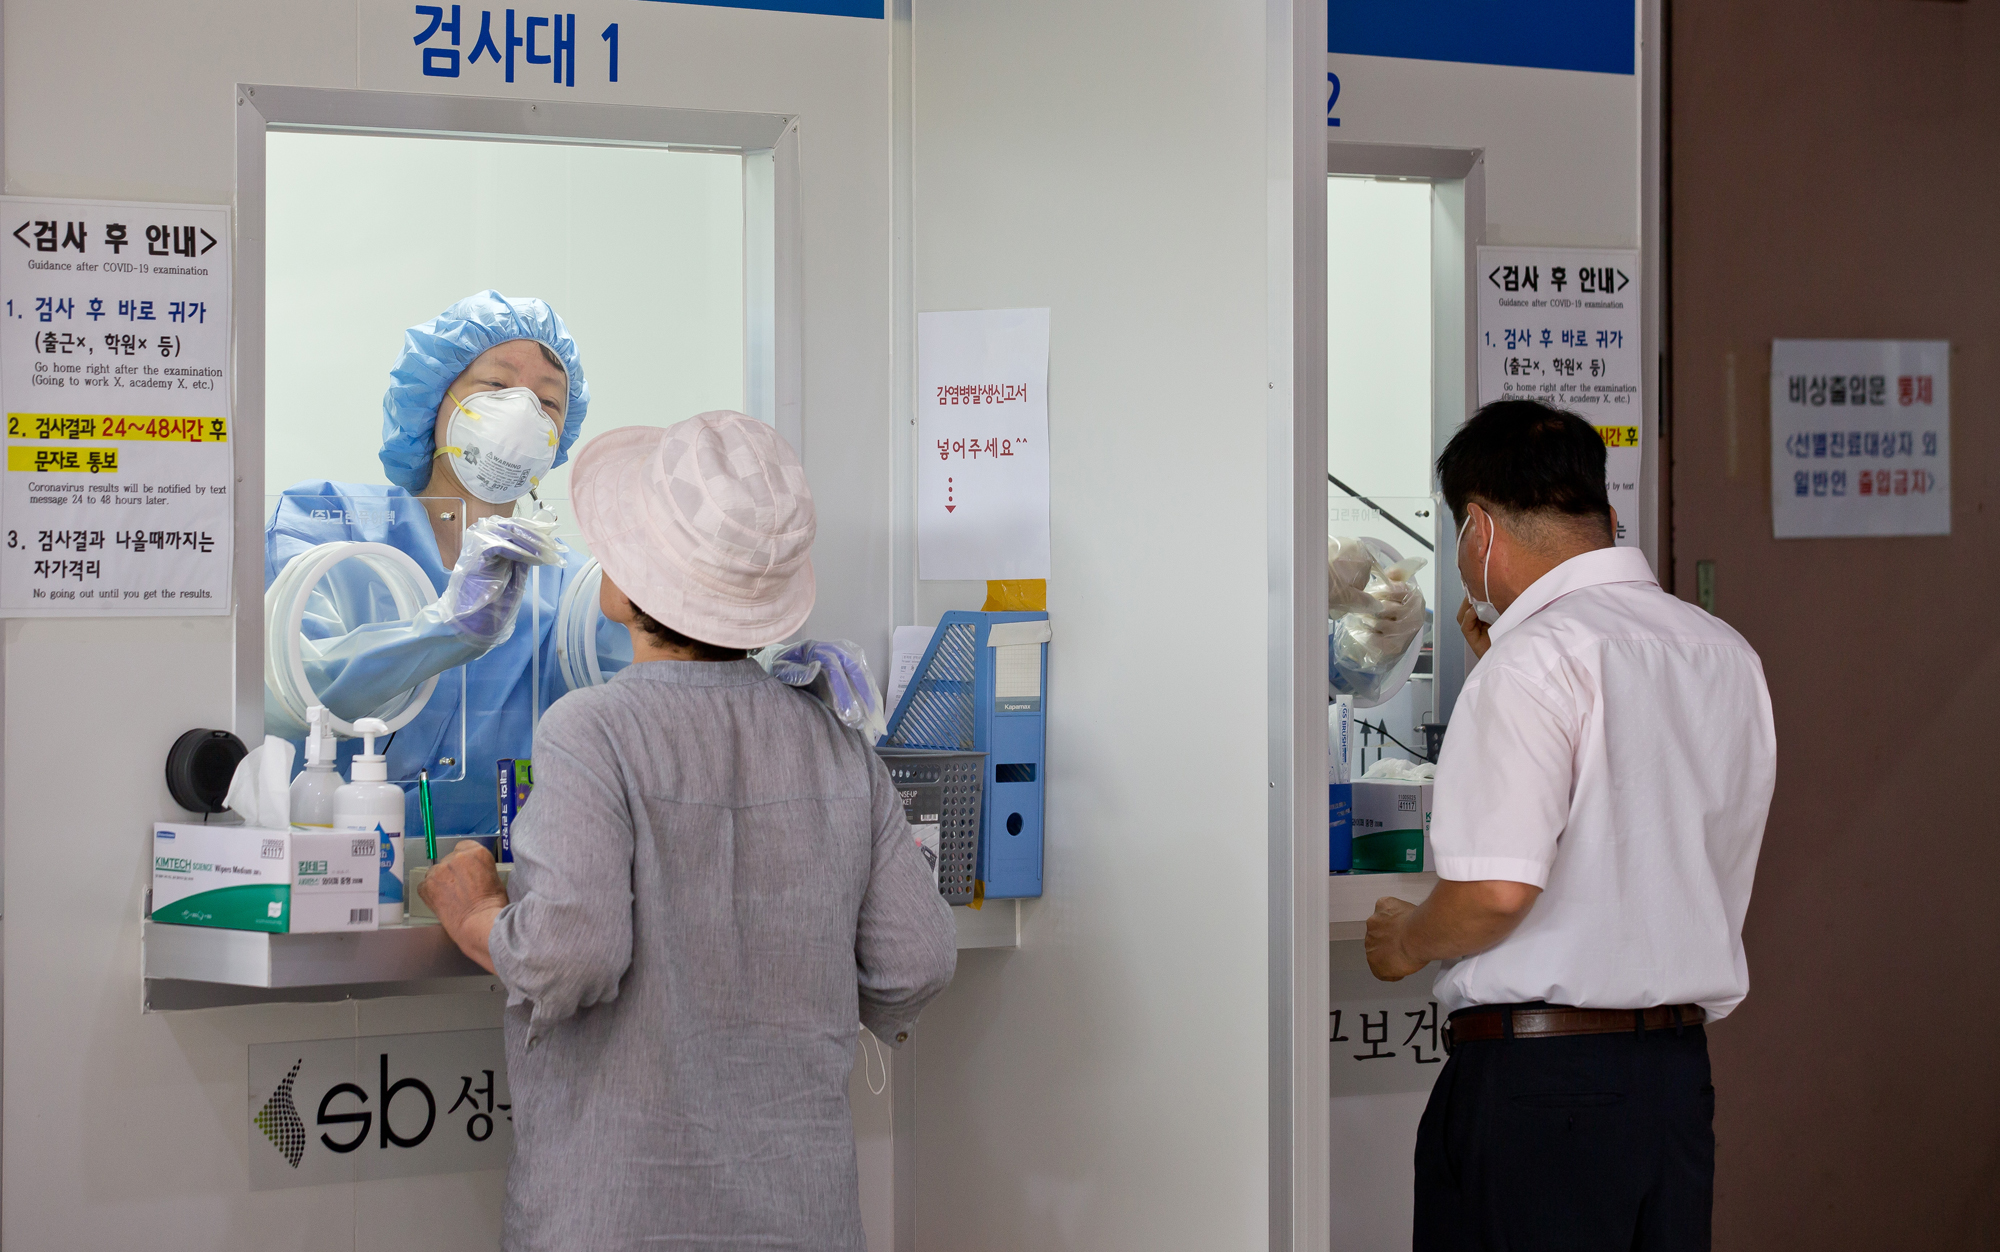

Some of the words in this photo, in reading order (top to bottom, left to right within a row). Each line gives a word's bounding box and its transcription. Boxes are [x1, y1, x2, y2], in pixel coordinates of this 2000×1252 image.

[413, 4, 575, 87] 검사대
[601, 23, 618, 82] 1
[1328, 72, 1340, 127] 2
[13, 220, 87, 253] <검사
[105, 223, 128, 254] 후
[146, 225, 218, 257] 안내>
[28, 260, 71, 271] Guidance
[76, 262, 99, 272] after
[103, 263, 149, 273] COVID-19
[153, 265, 209, 276] examination
[1489, 265, 1539, 292] <검사
[1550, 267, 1567, 292] 후
[1579, 268, 1630, 293] 안내>
[7, 299, 22, 319] 1.
[35, 297, 75, 322] 검사
[86, 297, 105, 321] 후
[119, 300, 156, 321] 바로
[168, 302, 206, 323] 귀가
[1499, 298, 1529, 308] Guidance
[1532, 299, 1547, 308] after
[1550, 299, 1582, 309] COVID-19
[1585, 300, 1624, 309] examination
[158, 335, 181, 357] 등)
[1485, 331, 1496, 348] 1.
[1504, 328, 1531, 349] 검사
[1539, 328, 1553, 348] 후
[1562, 330, 1588, 348] 바로
[1596, 330, 1623, 349] 귀가
[35, 362, 48, 372] Go
[53, 363, 81, 374] home
[86, 364, 110, 375] right
[115, 364, 139, 375] after
[143, 365, 159, 375] the
[164, 366, 223, 377] examination
[1589, 358, 1606, 377] 등)
[32, 375, 64, 387] (Going
[70, 376, 80, 386] to
[85, 376, 109, 387] work
[130, 378, 172, 390] academy
[193, 379, 214, 391] etc.)
[1504, 382, 1513, 391] Go
[1516, 382, 1536, 392] home
[1540, 383, 1556, 393] right
[1560, 383, 1576, 392] after
[1580, 383, 1591, 392] the
[1594, 383, 1636, 393] examination
[1789, 374, 1885, 406] 비상출입문
[1898, 374, 1933, 407] 통제
[937, 382, 1027, 405] 감염병발생신고서
[1570, 394, 1600, 404] academy
[1614, 394, 1630, 404] etc.)
[9, 417, 26, 437] 2.
[36, 417, 96, 440] 검사결과
[209, 419, 227, 441] 후
[1625, 427, 1638, 445] 후
[1923, 432, 1937, 456] 외
[35, 451, 80, 472] 문자로
[86, 451, 118, 473] 통보
[493, 455, 521, 470] WARNING
[28, 482, 84, 492] Coronavirus
[88, 484, 119, 493] results
[123, 483, 138, 492] will
[143, 484, 153, 493] be
[157, 484, 191, 494] notified
[195, 485, 206, 495] by
[210, 485, 227, 494] text
[1613, 483, 1620, 491] by
[1794, 470, 1847, 497] 일반인
[30, 496, 67, 505] message
[72, 495, 83, 504] 24
[87, 495, 96, 504] to
[101, 495, 111, 504] 48
[115, 495, 142, 505] hours
[146, 496, 169, 505] later.
[7, 530, 26, 550] 3.
[38, 530, 105, 551] 검사결과
[116, 530, 215, 552] 나올때까지는
[34, 559, 100, 582] 자가격리
[33, 589, 46, 598] No
[50, 590, 75, 600] going
[80, 589, 94, 598] out
[99, 589, 119, 598] until
[123, 591, 139, 600] you
[144, 590, 157, 600] get
[161, 589, 176, 598] the
[179, 589, 212, 599] results.
[1342, 708, 1348, 719] GS
[262, 847, 283, 857] 41117
[353, 846, 374, 855] 41117
[155, 857, 192, 869] KIMTECH
[192, 862, 213, 872] SCIENCE
[215, 864, 232, 874] Wipers
[233, 866, 252, 875] Medium
[317, 1054, 436, 1153] sb
